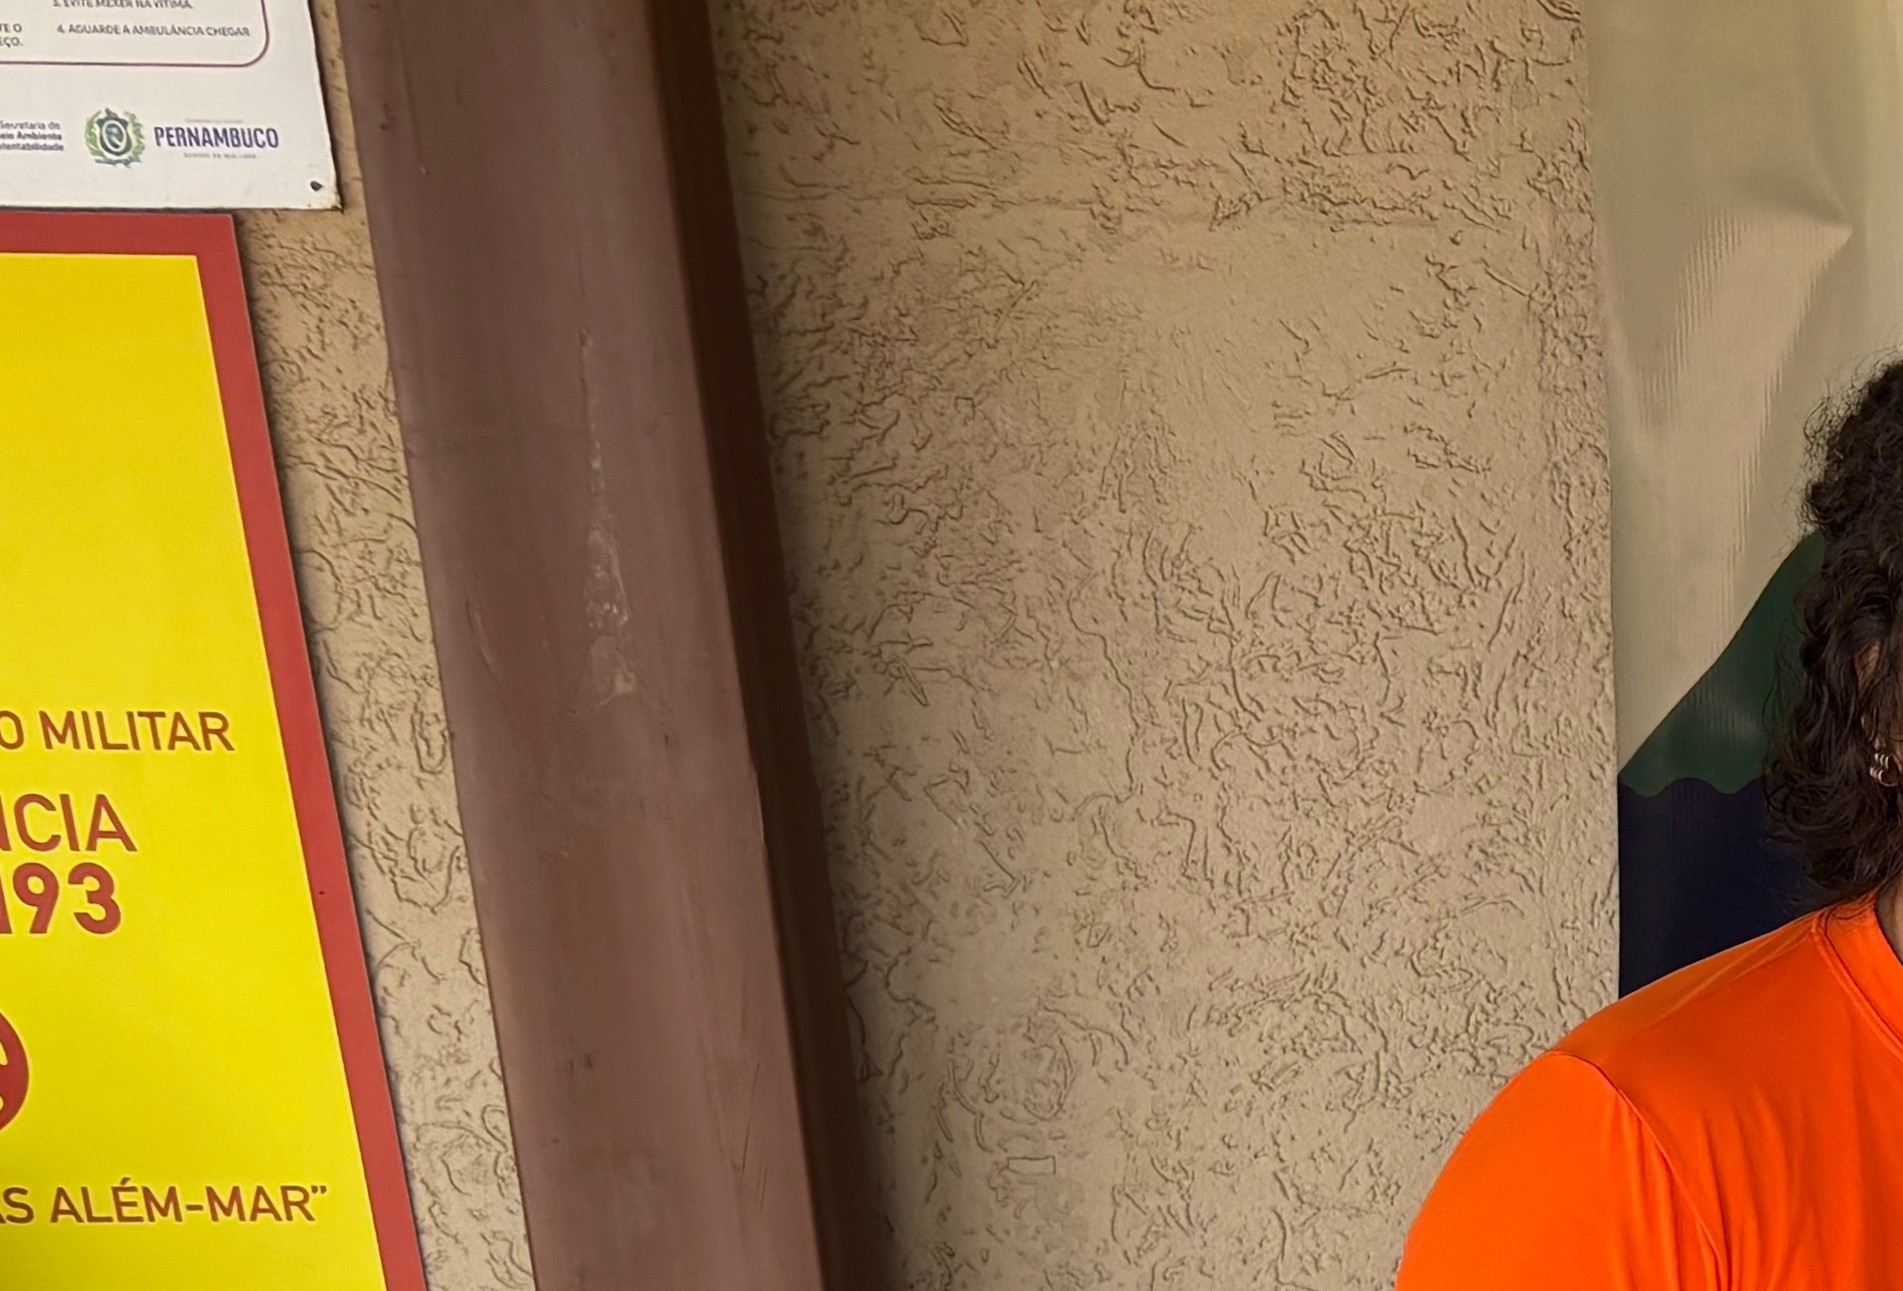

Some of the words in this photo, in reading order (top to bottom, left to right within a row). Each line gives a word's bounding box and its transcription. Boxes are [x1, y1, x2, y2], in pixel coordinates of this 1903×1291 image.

[69, 24, 121, 35] AGUARDE
[122, 25, 131, 35] A
[132, 24, 205, 36] AMBULÂNCIA
[207, 26, 250, 37] CHEGAR
[154, 126, 280, 149] PERNAMBUCO
[39, 710, 235, 751] MILITAR
